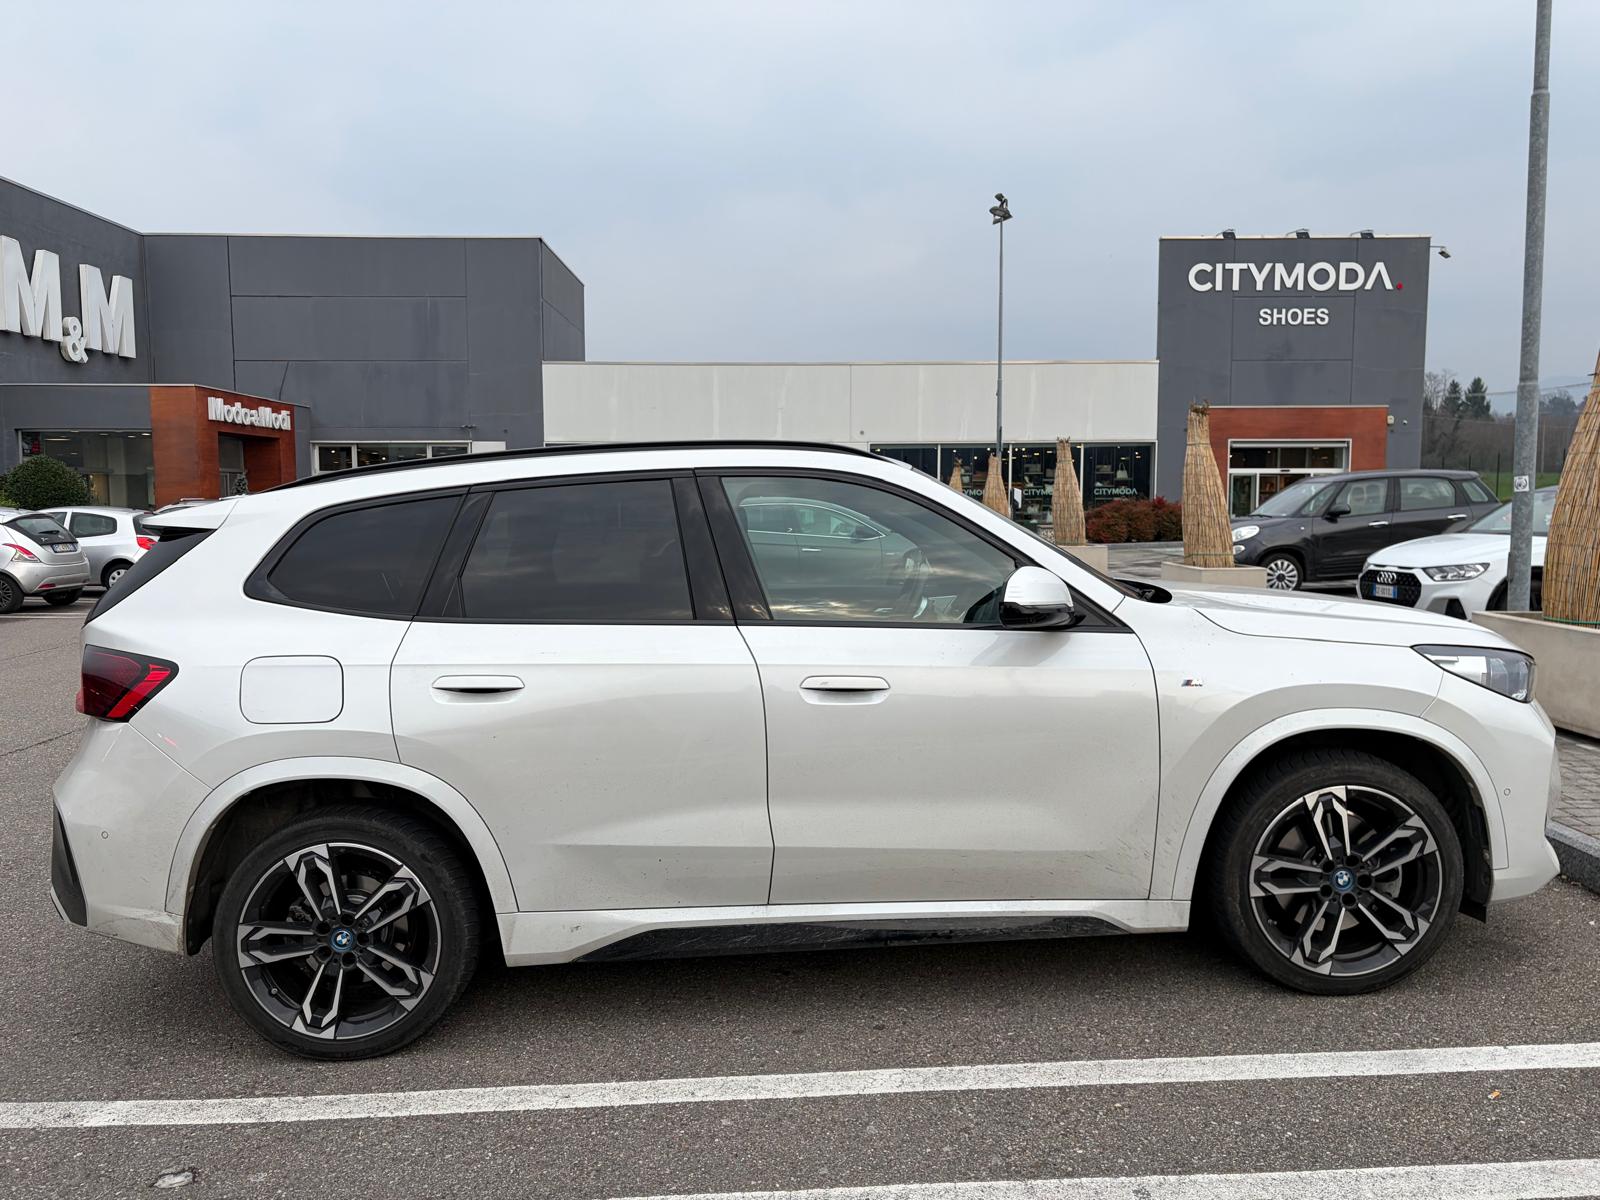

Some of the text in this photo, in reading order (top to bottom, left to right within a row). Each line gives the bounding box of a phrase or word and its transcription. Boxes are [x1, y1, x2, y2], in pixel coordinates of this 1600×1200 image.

[0, 234, 137, 364] M&M
[1258, 307, 1330, 326] SHOES
[1093, 487, 1138, 496] CITYMODA
